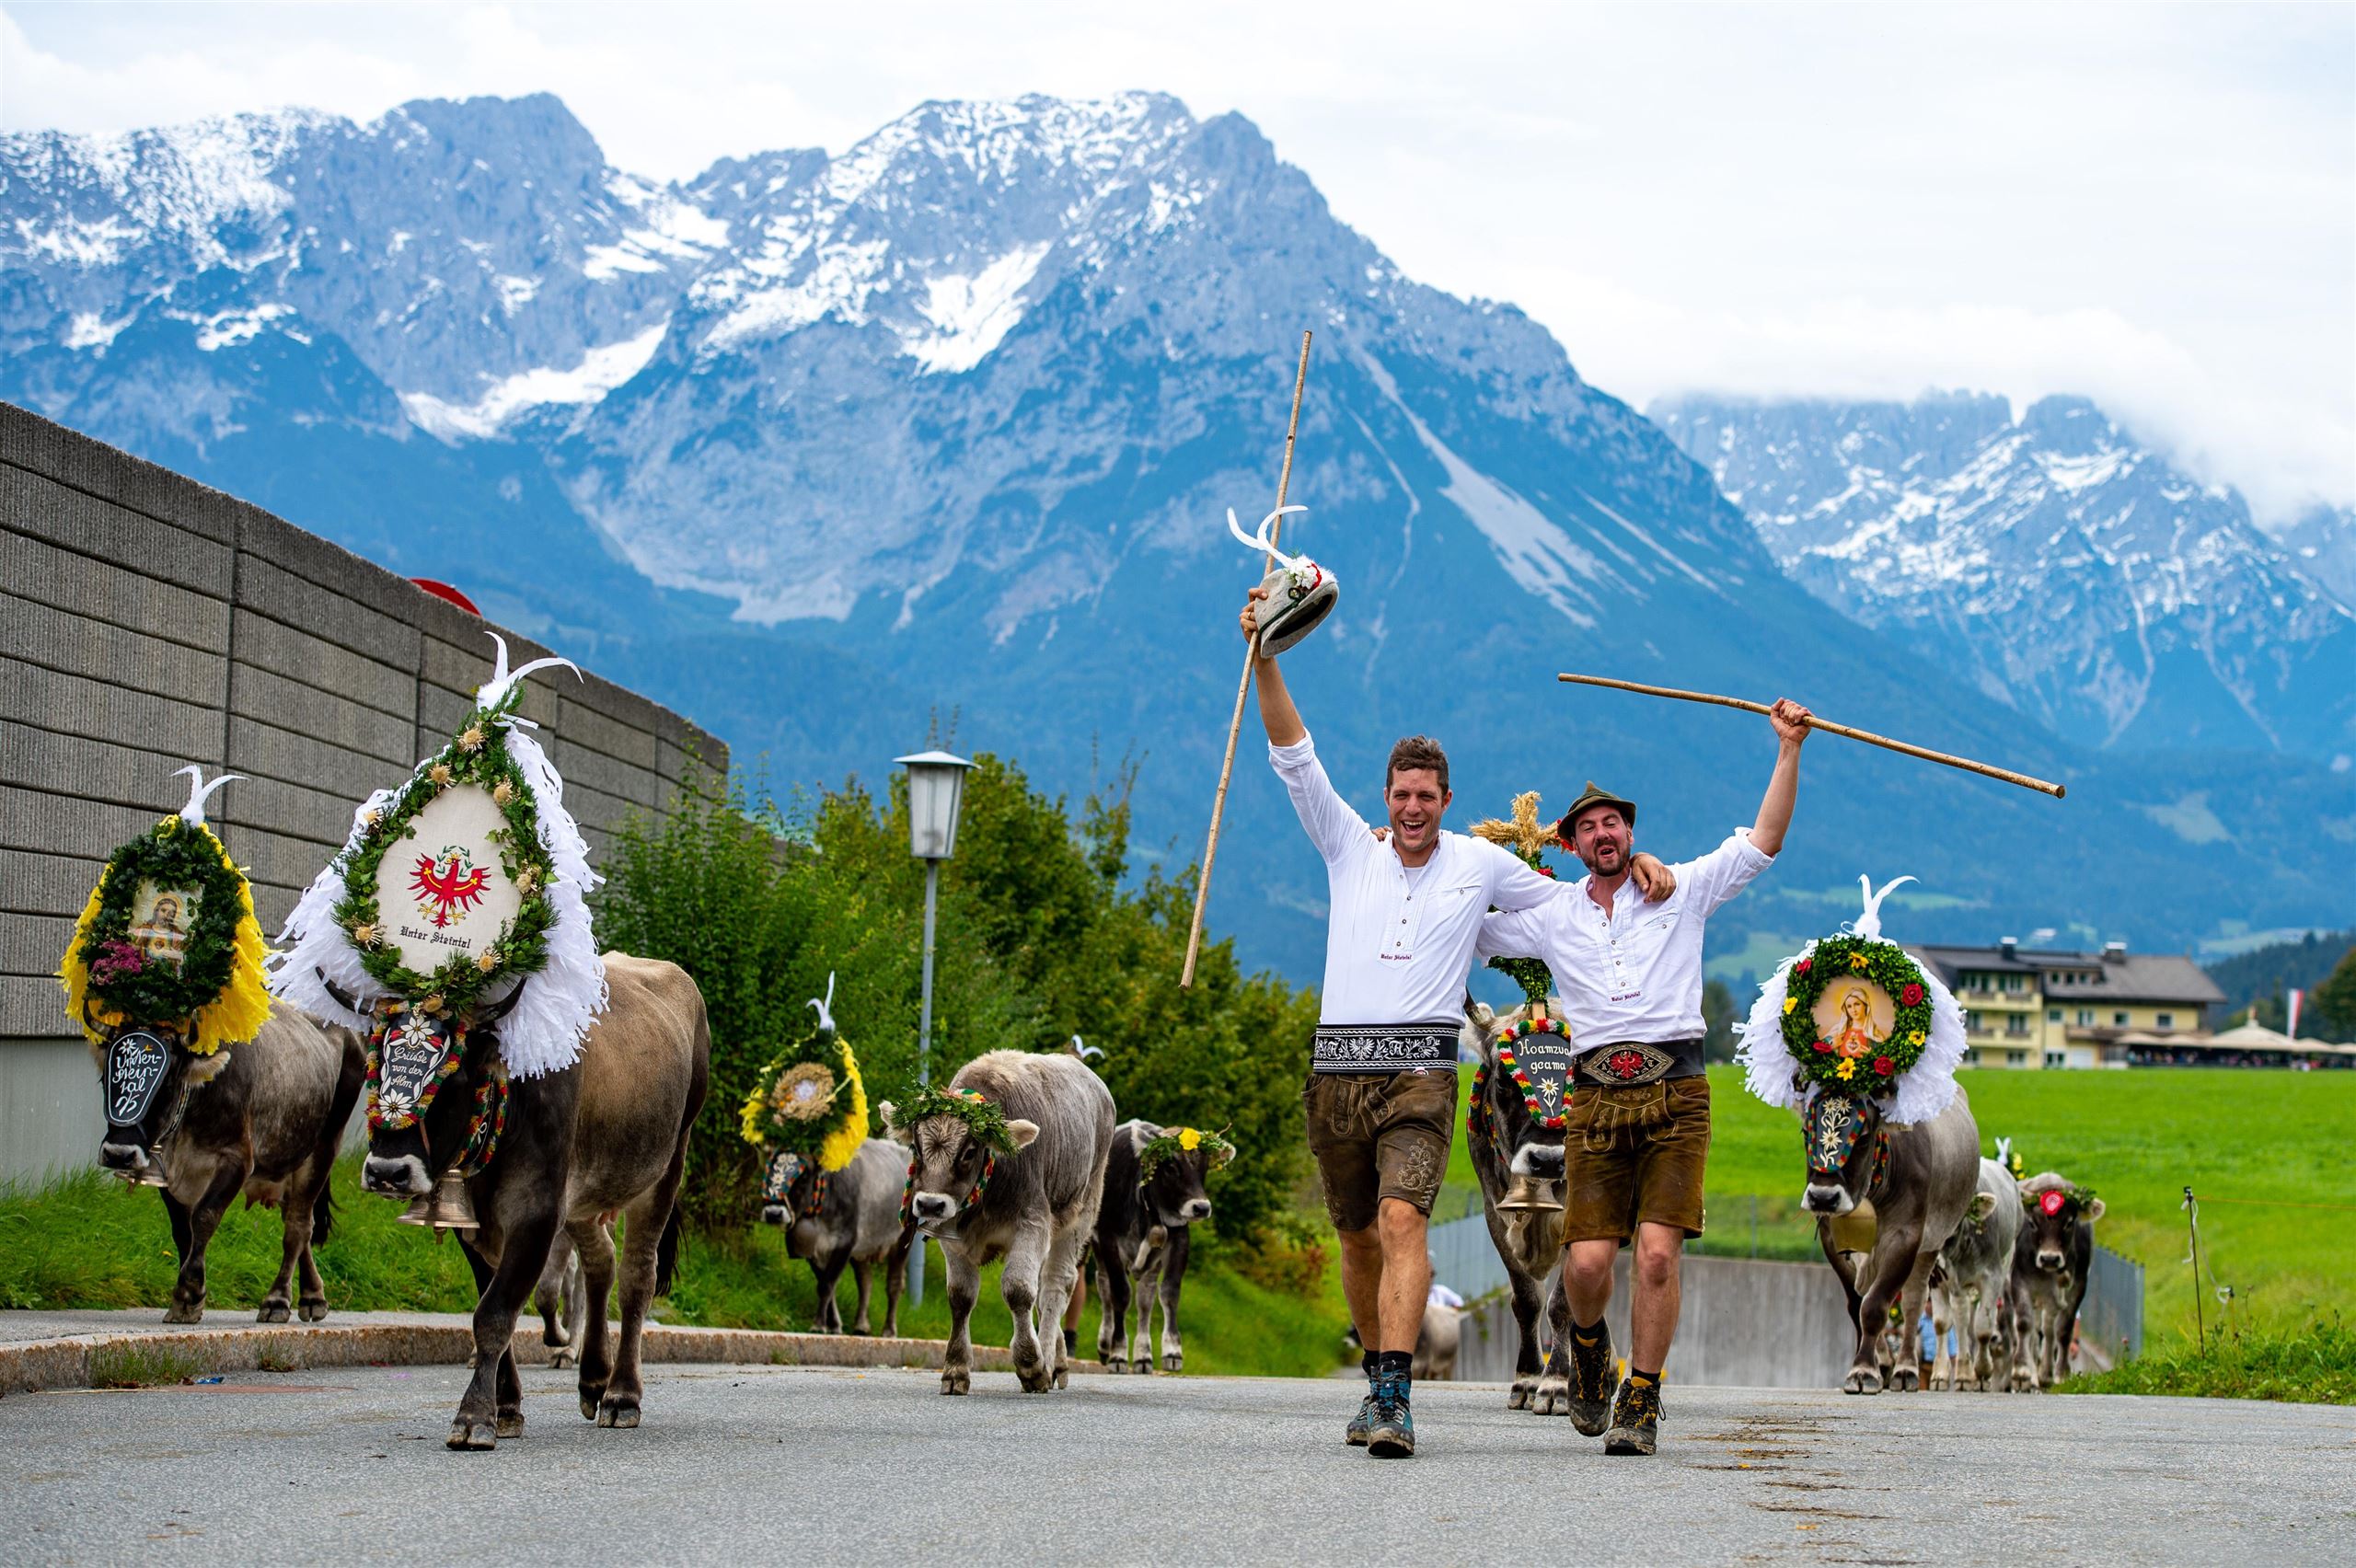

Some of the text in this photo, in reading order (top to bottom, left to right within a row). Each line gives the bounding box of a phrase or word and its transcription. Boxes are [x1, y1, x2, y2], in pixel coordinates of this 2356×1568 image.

[399, 926, 428, 940] Unter
[392, 1064, 423, 1076] von der
[390, 1075, 412, 1089] Alm
